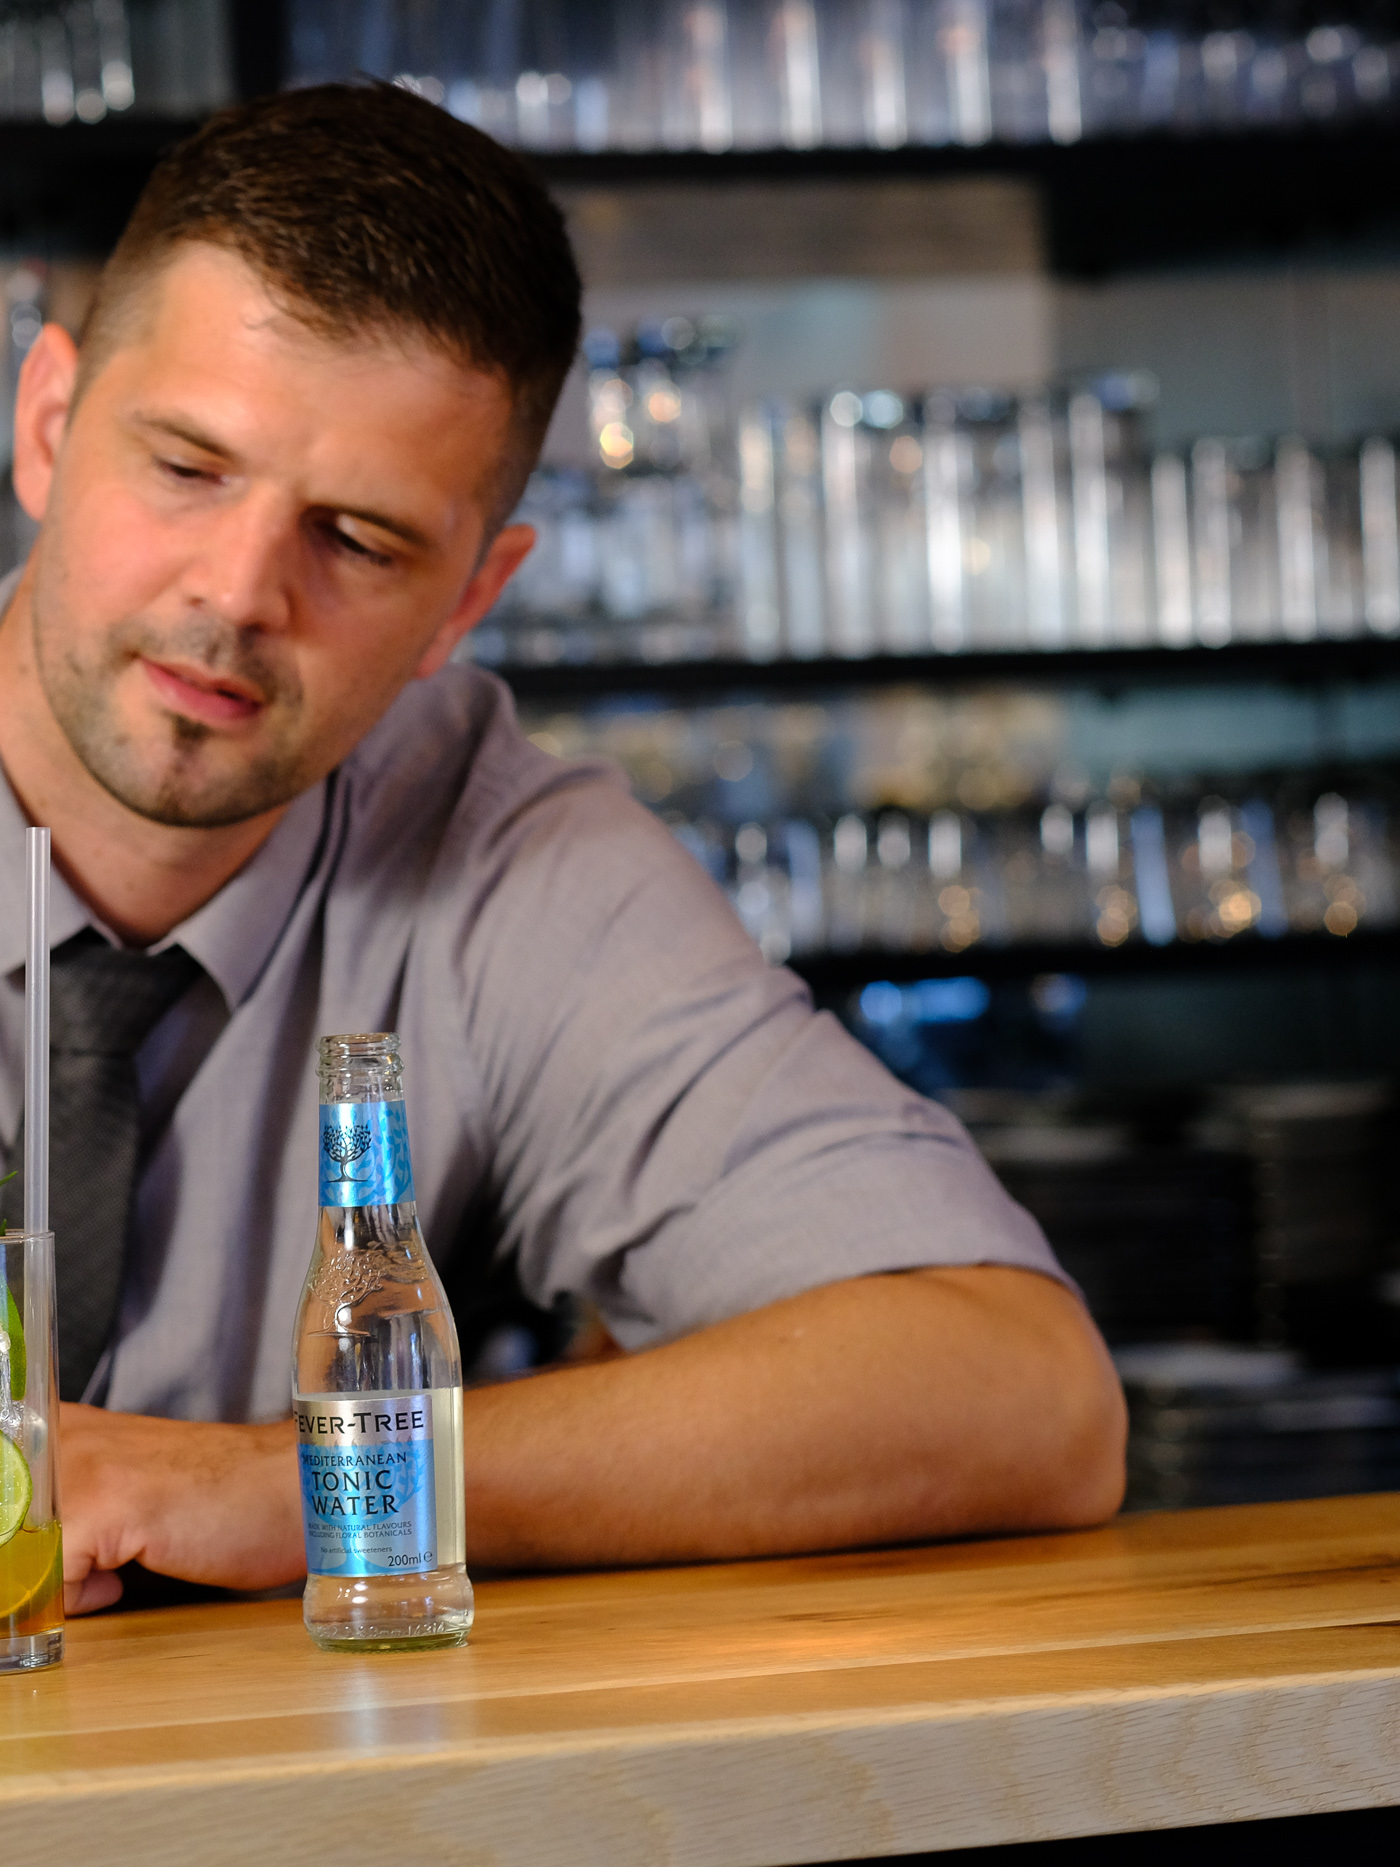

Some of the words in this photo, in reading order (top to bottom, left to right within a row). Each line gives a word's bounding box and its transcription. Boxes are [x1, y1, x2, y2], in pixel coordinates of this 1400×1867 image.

[302, 1452, 407, 1466] MEDITERRANEAN
[312, 1470, 392, 1491] TONIC
[312, 1495, 399, 1516] WATER
[322, 1523, 336, 1531] WITH
[338, 1523, 371, 1531] NATURAL
[373, 1521, 412, 1530] FLAVOURS
[364, 1529, 413, 1538] BOTANICALS
[388, 1553, 421, 1567] 200ml
